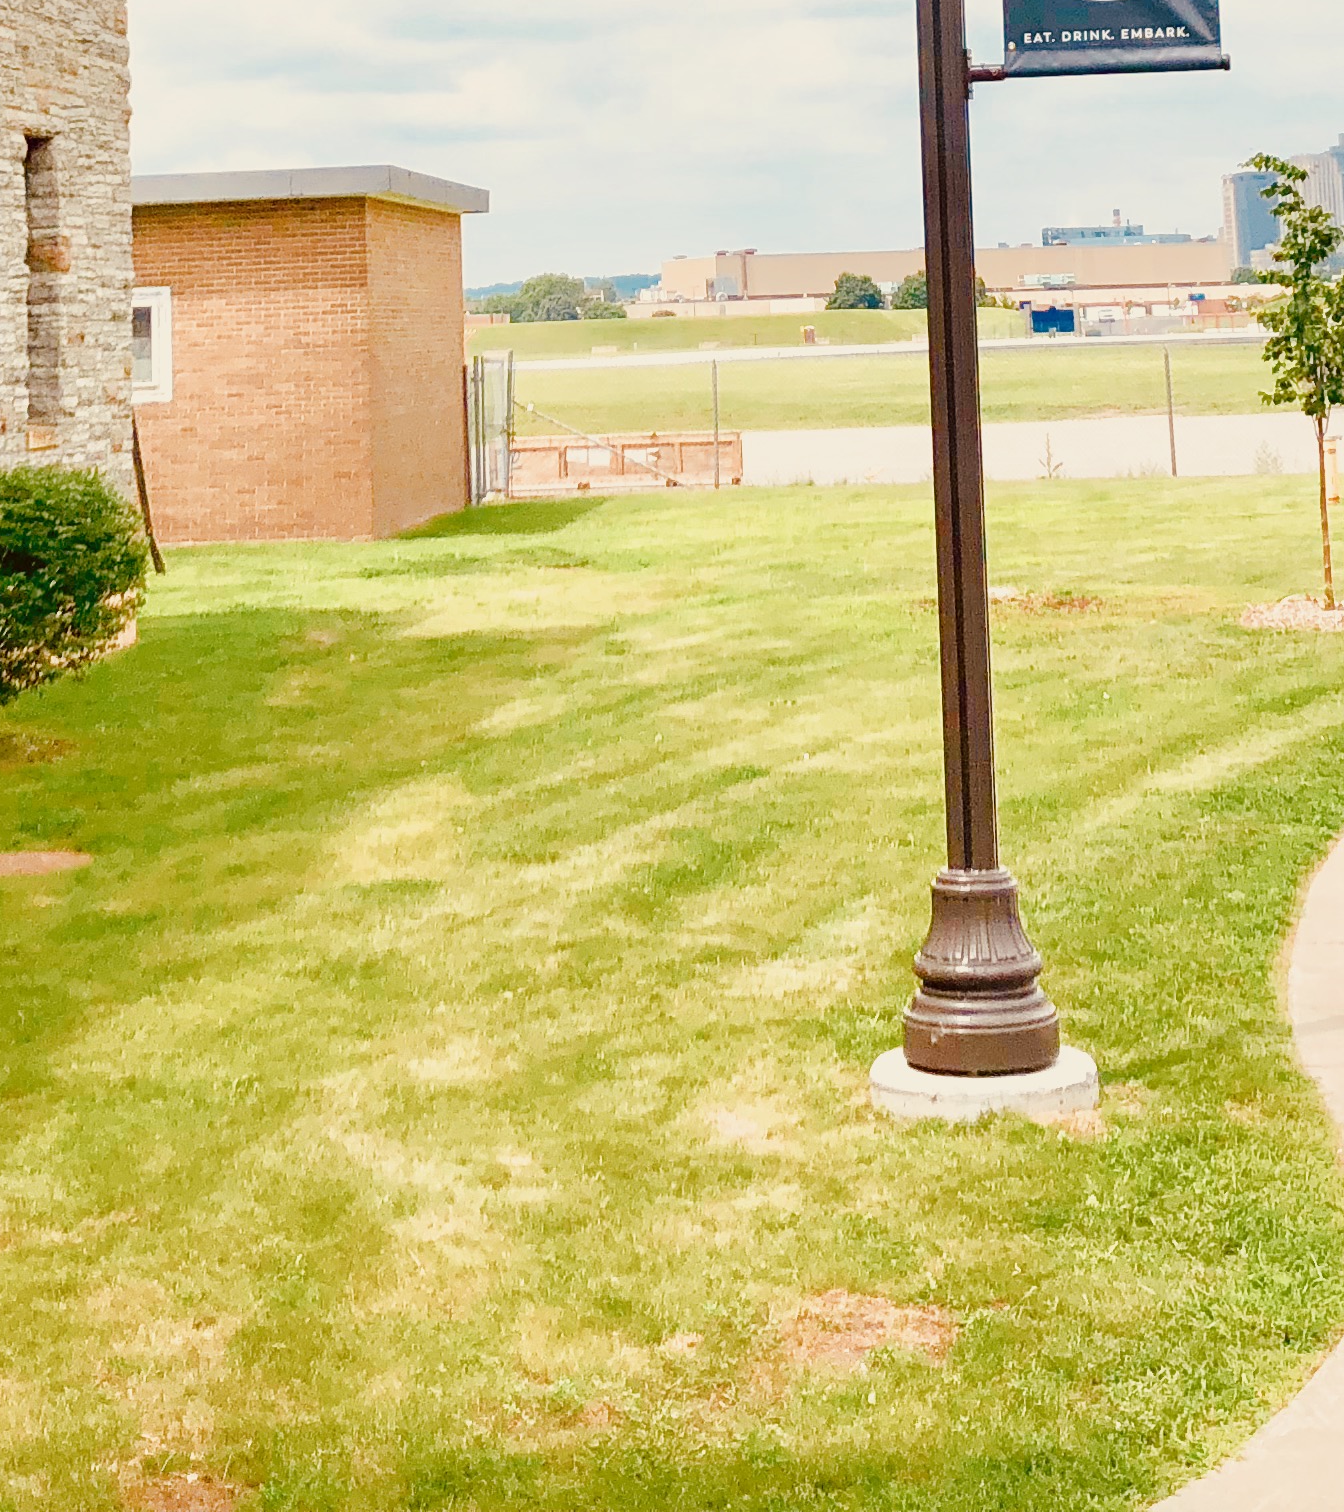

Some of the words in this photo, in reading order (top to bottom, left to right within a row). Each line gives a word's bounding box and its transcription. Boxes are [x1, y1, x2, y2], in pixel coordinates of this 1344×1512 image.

[1023, 31, 1056, 44] EAT.
[1061, 29, 1115, 42] DRINK.
[1120, 26, 1190, 40] EMBARK.
